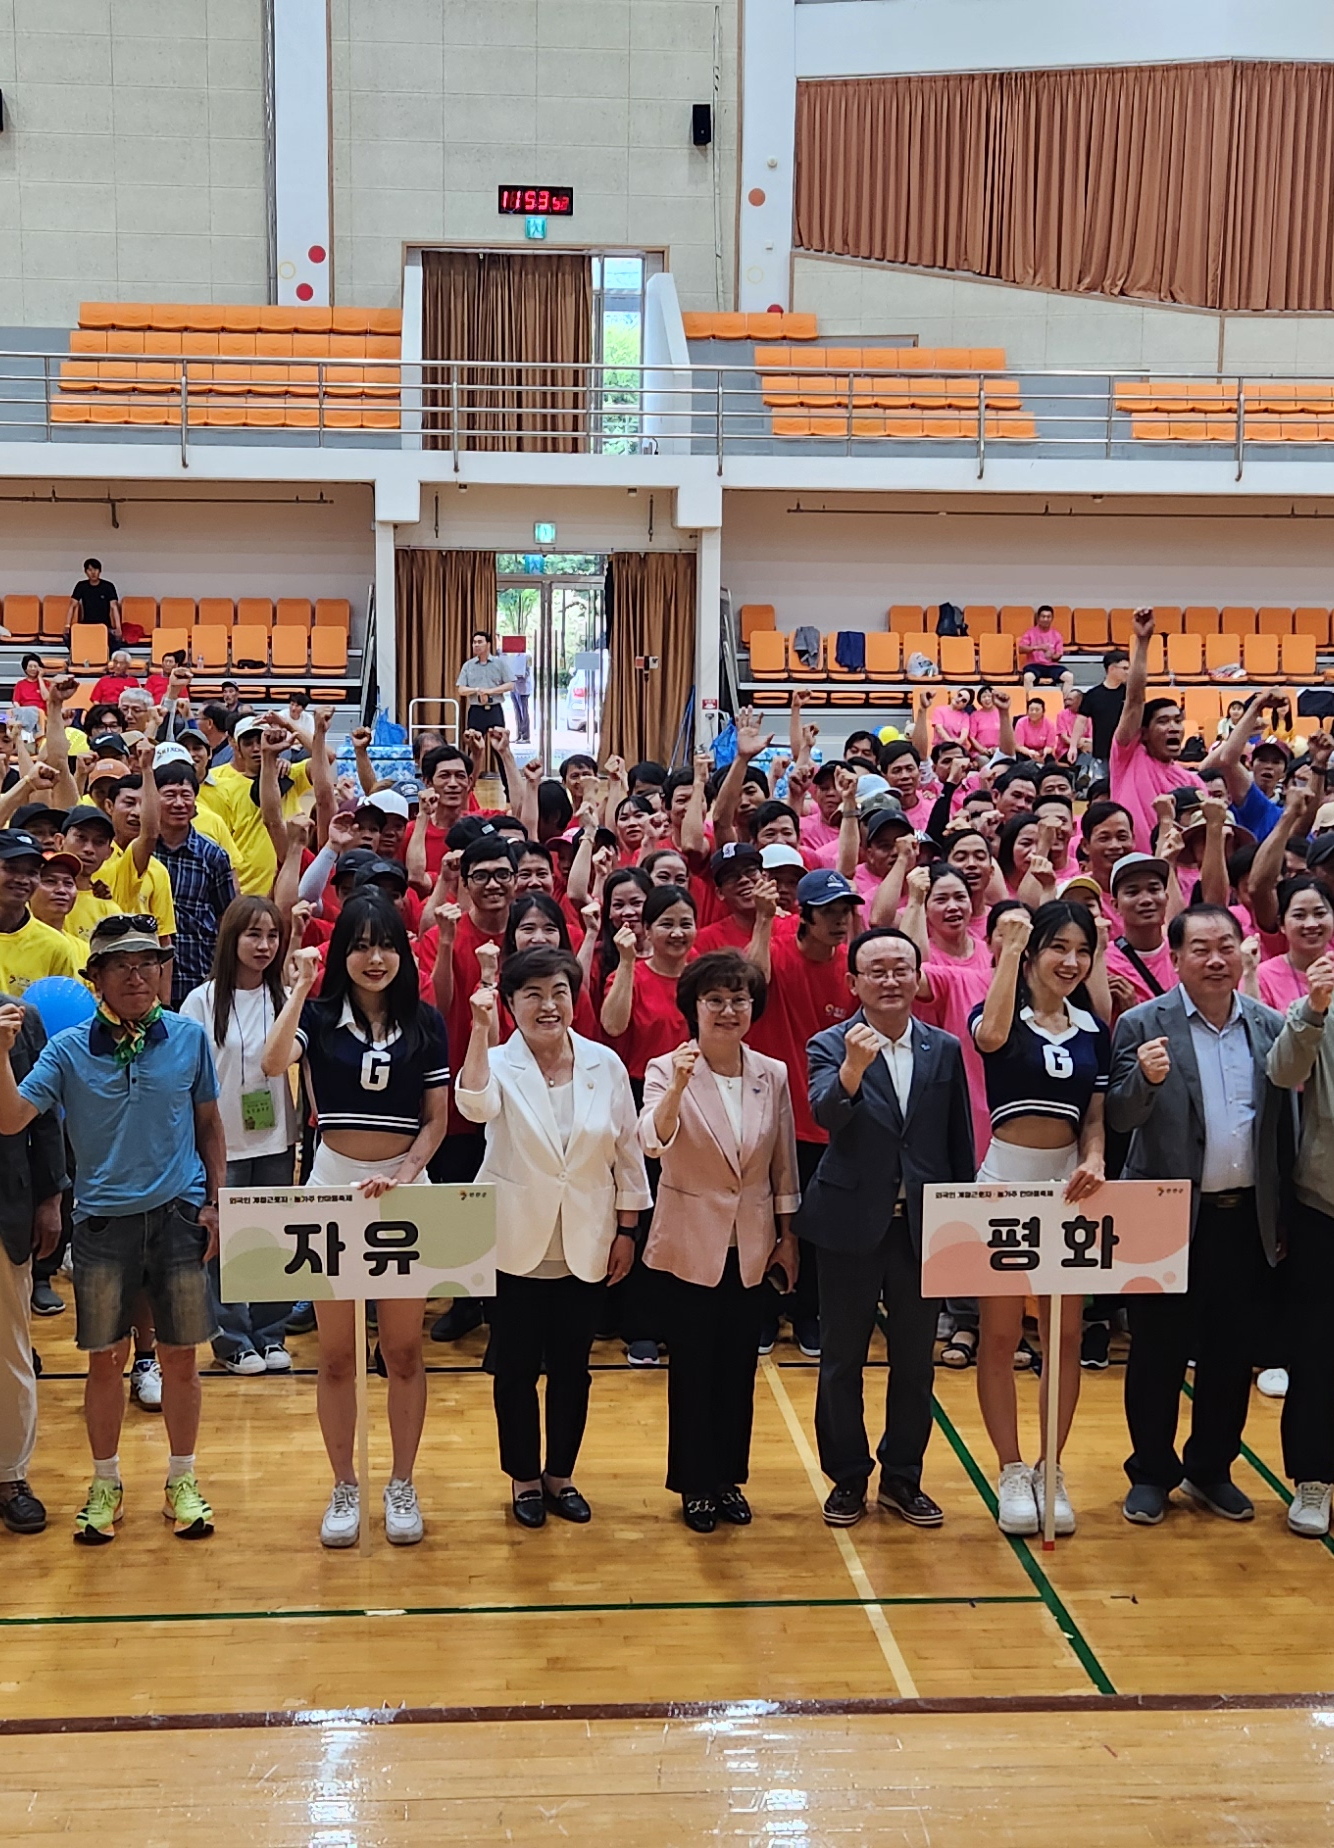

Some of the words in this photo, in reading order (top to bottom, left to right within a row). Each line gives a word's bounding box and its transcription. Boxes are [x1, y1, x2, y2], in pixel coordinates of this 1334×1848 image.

[360, 1050, 392, 1091] G
[1042, 1044, 1074, 1079] G
[229, 1197, 251, 1205] 외국인
[284, 1221, 420, 1277] 자유
[987, 1215, 1119, 1271] 평화
